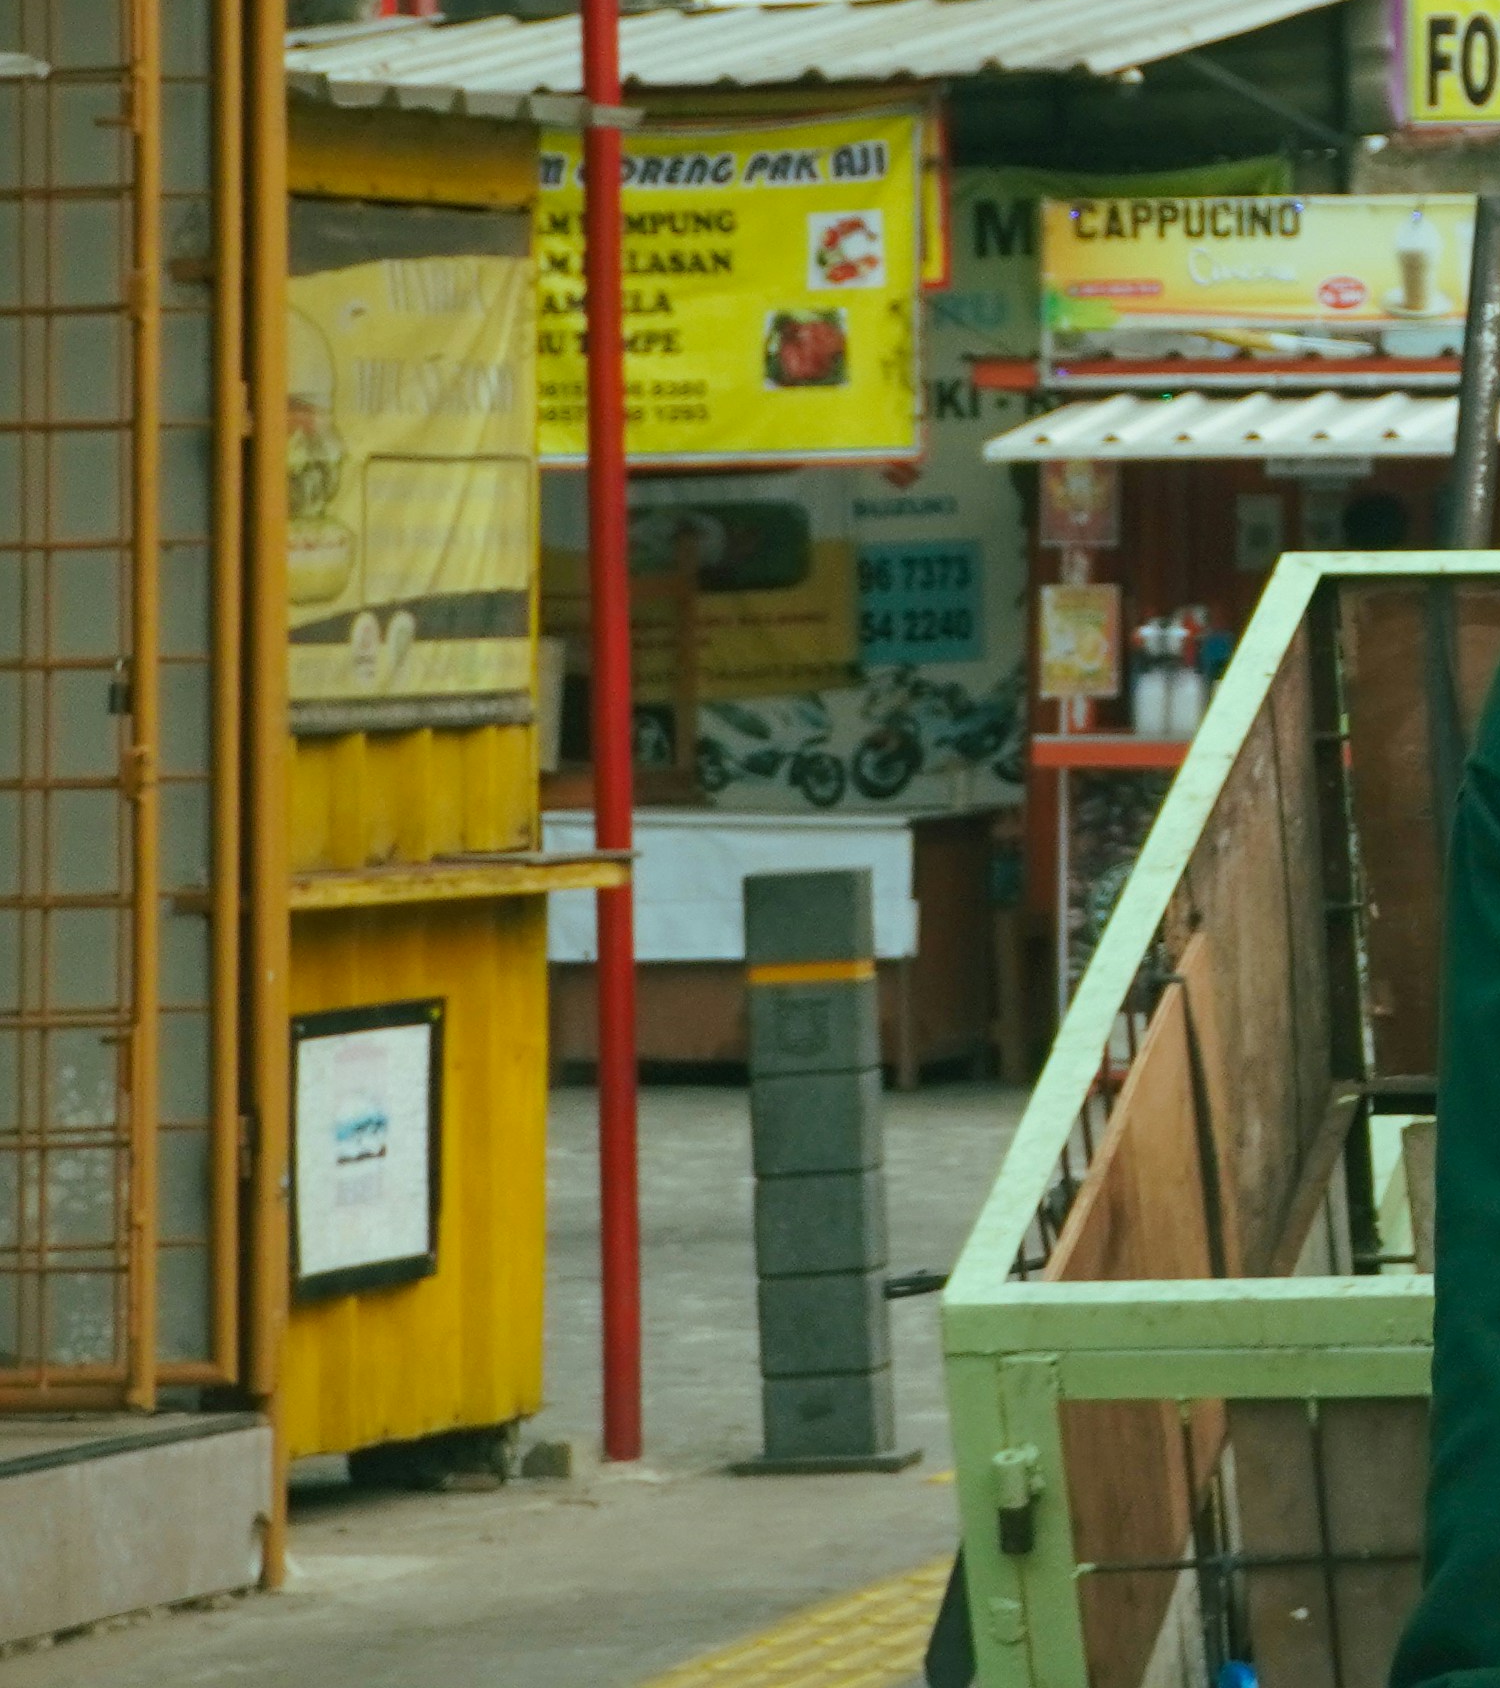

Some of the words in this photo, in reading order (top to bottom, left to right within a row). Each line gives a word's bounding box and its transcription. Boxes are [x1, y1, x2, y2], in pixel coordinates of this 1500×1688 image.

[743, 148, 821, 185] PAK
[832, 141, 888, 179] AJI
[1074, 200, 1303, 240] CAPPUCINO
